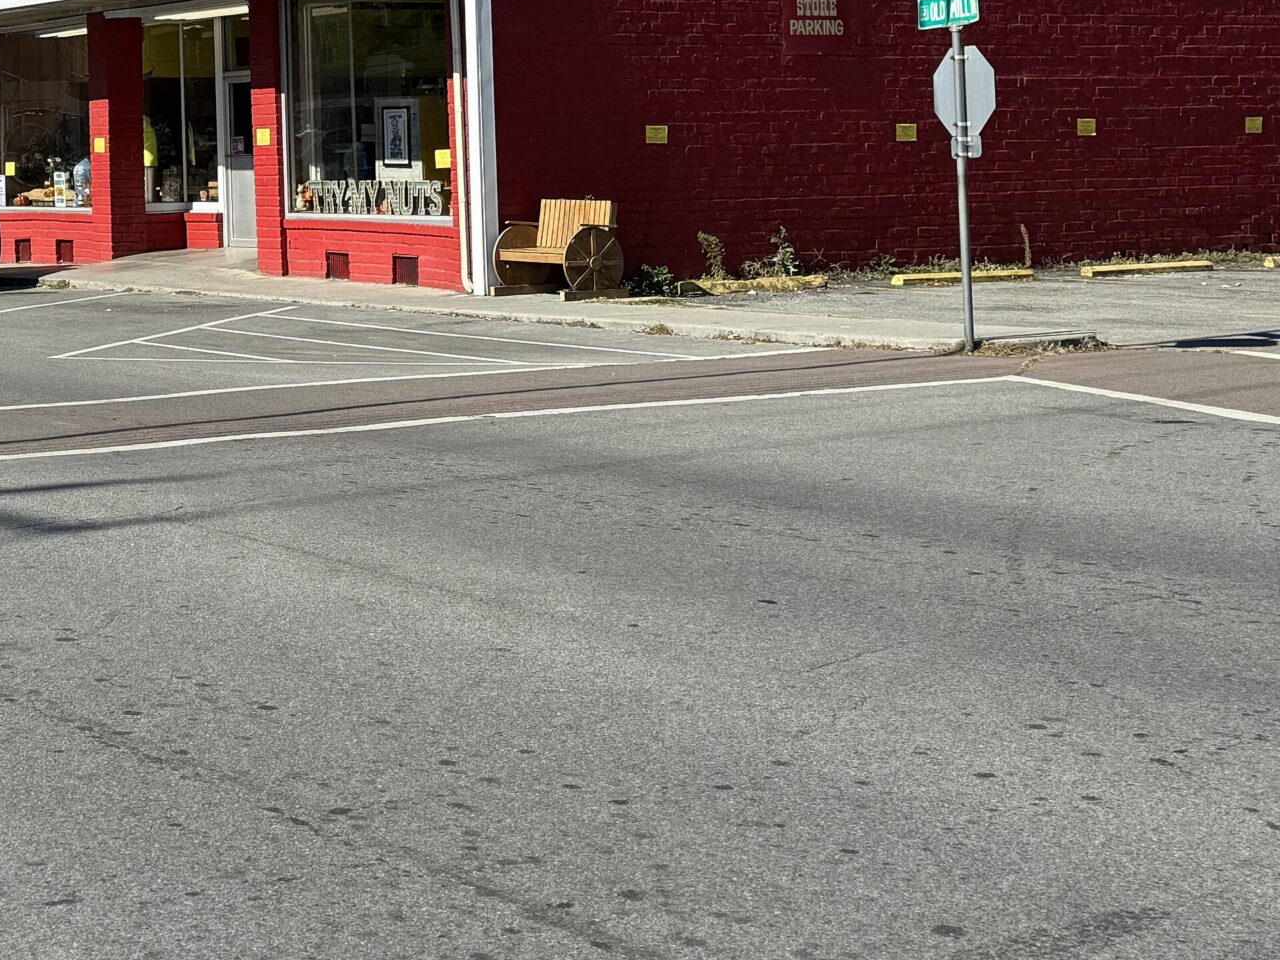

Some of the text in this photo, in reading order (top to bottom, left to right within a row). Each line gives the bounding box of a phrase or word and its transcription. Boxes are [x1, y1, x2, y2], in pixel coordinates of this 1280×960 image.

[929, 0, 946, 22] OLD
[789, 19, 844, 36] PARKING
[308, 181, 442, 216] TRY MY NUTS
